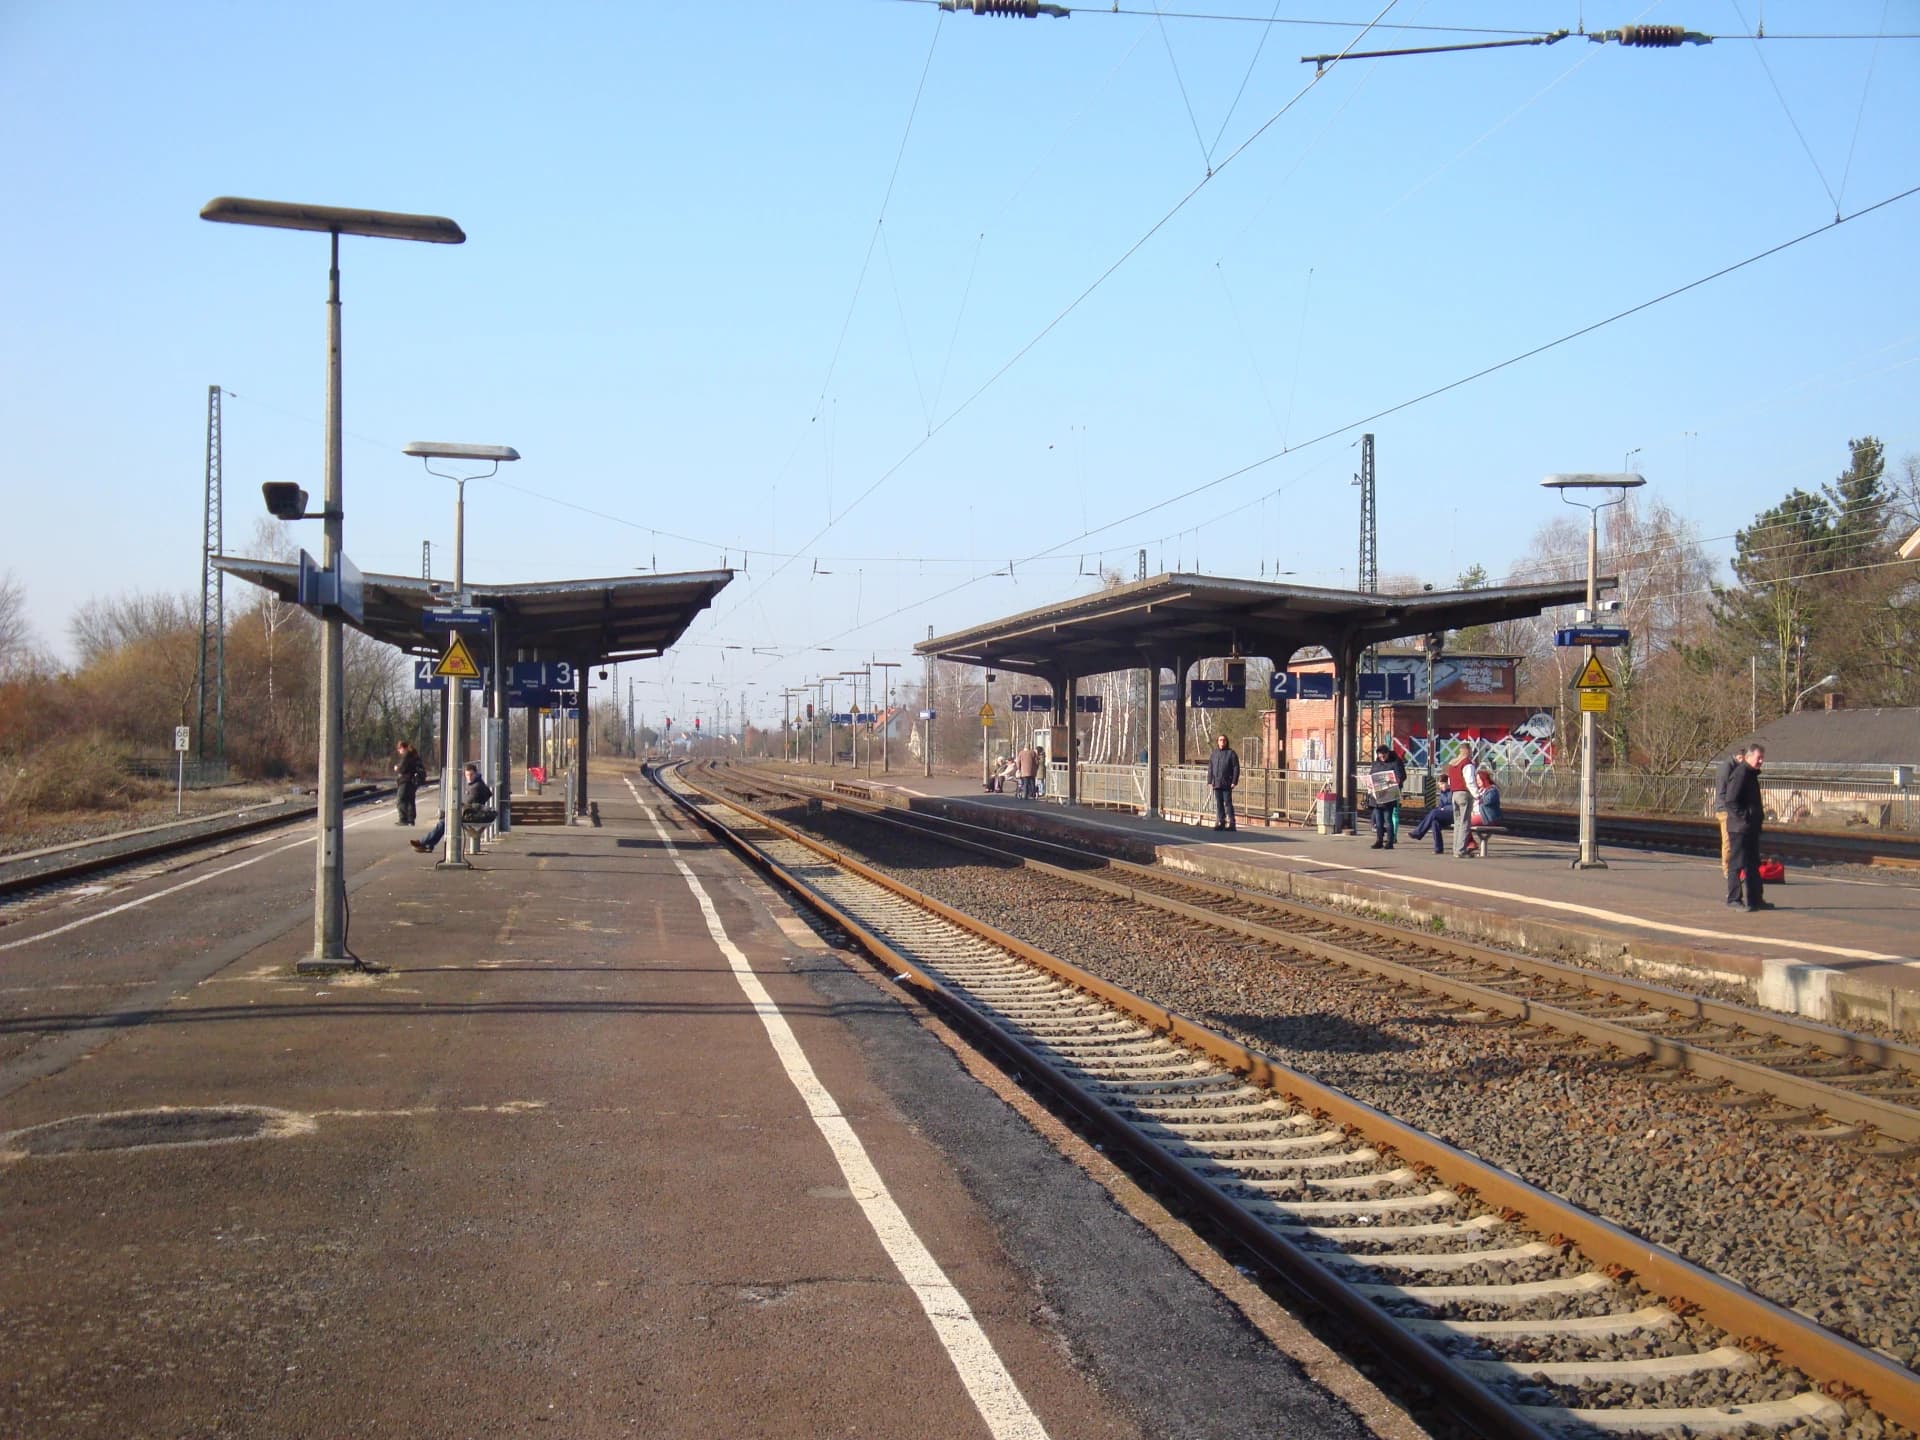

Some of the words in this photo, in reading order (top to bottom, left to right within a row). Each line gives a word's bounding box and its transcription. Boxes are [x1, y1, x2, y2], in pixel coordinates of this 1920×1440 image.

[418, 662, 433, 684] 4
[556, 662, 571, 684] 3
[1207, 681, 1215, 692] 3
[1274, 672, 1287, 693] 2
[1403, 673, 1411, 694] 1
[568, 692, 578, 705] 3
[1014, 695, 1023, 708] 2
[180, 738, 185, 747] 2
